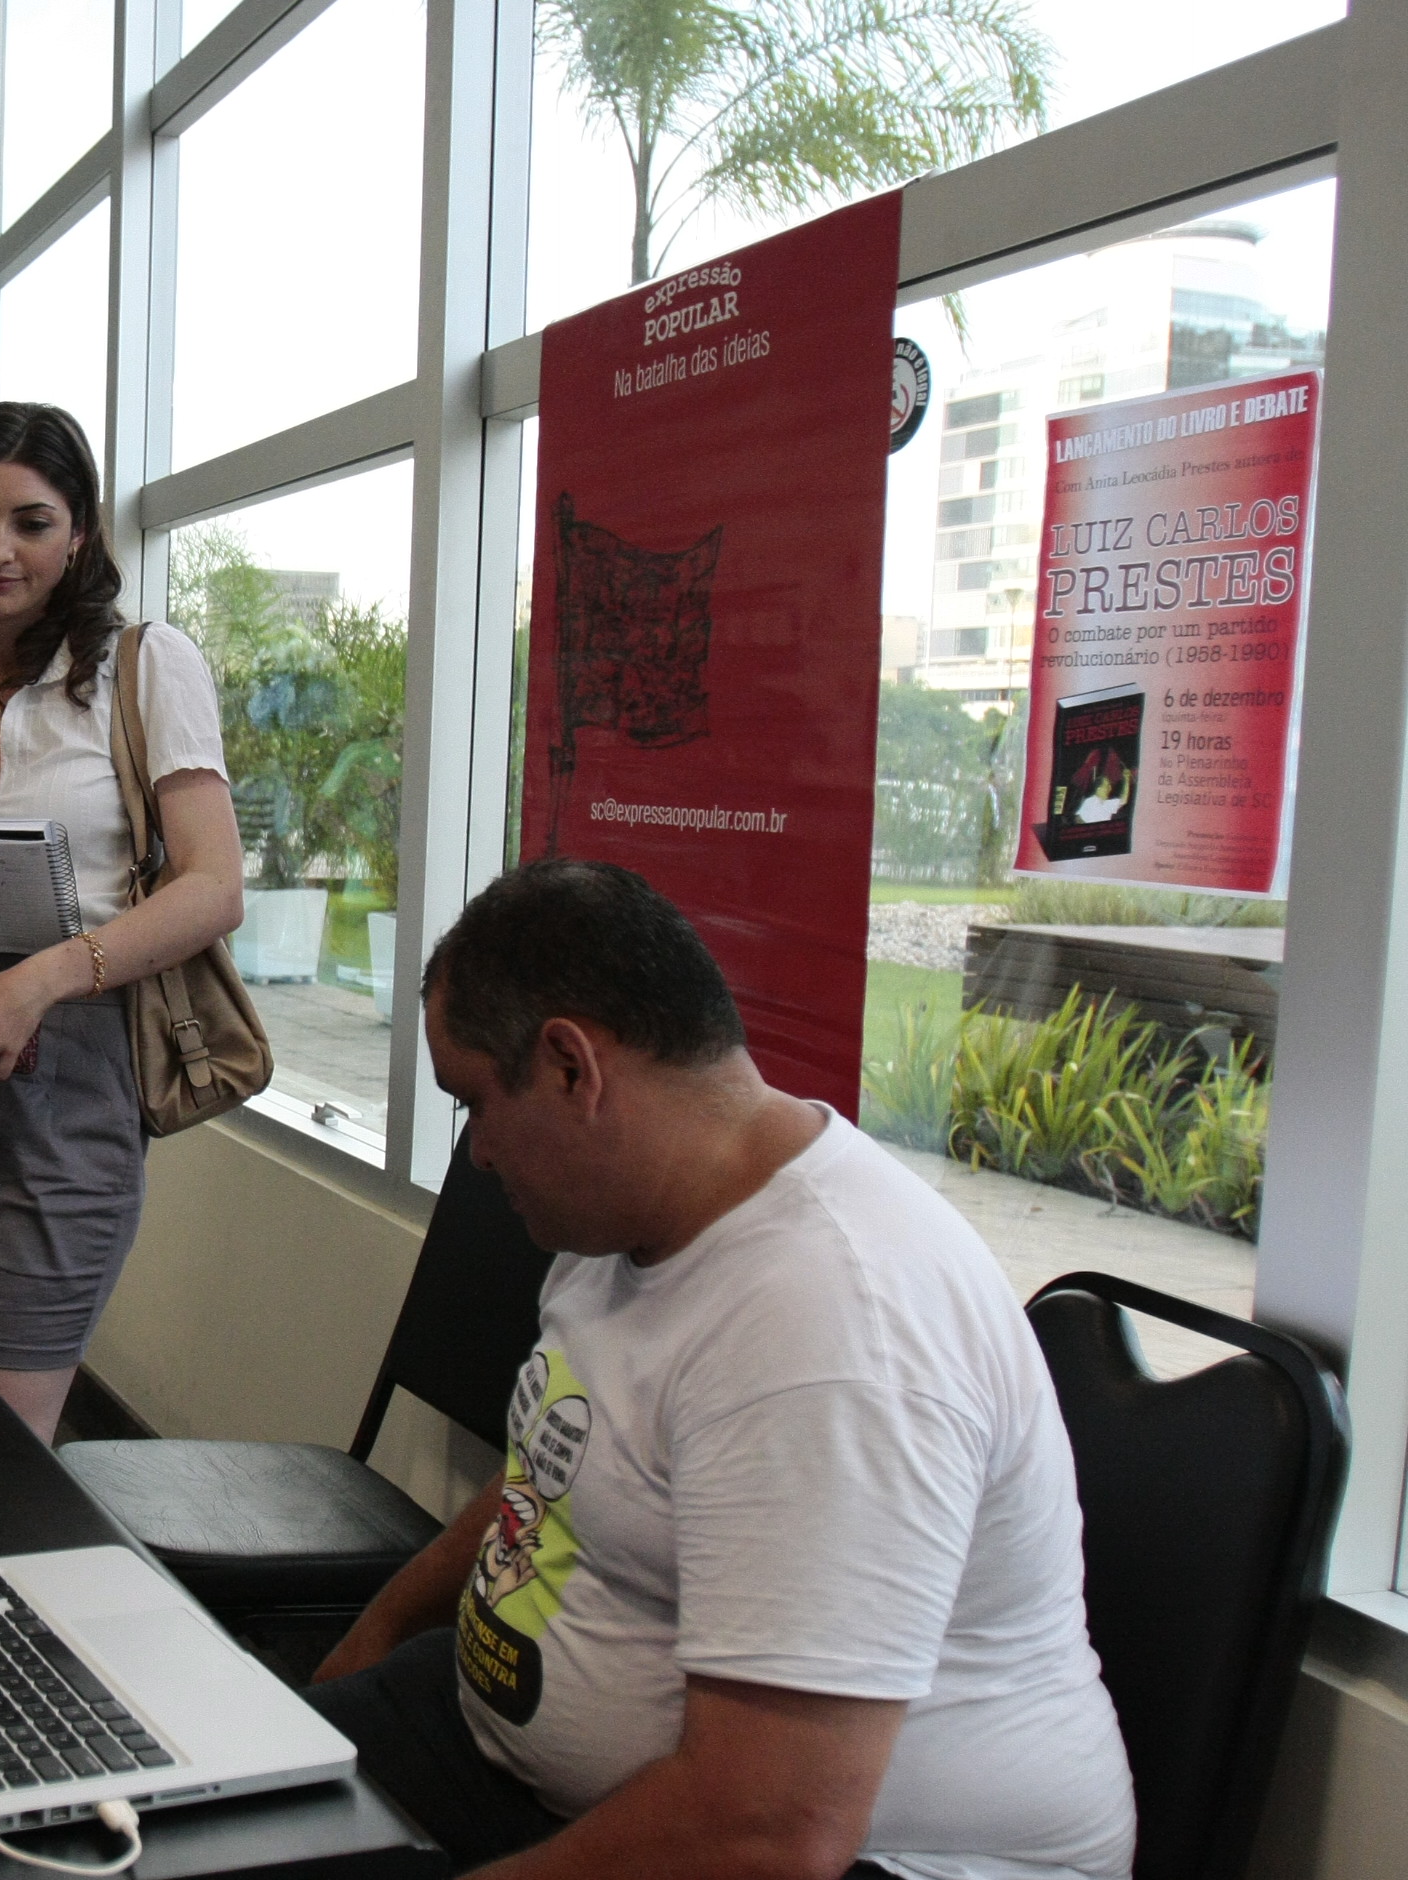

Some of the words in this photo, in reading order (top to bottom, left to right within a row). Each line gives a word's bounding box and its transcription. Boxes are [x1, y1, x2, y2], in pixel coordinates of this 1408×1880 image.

[643, 261, 742, 314] expressão
[643, 290, 740, 346] POPULAR
[614, 369, 632, 398] Na
[635, 354, 686, 392] batalha
[691, 345, 718, 376] das
[723, 329, 771, 366] ideias
[896, 342, 918, 361] não
[915, 367, 929, 406] legal
[1055, 420, 1152, 463] LANÇAMENTO
[1157, 417, 1177, 443] DO
[1180, 403, 1226, 438] LIVRO
[1230, 400, 1241, 427] E
[1244, 385, 1309, 424] DEBATE
[1055, 479, 1082, 495] Com
[1085, 475, 1119, 491] Anita
[1122, 465, 1177, 487] Leocádia
[1181, 459, 1231, 478] Prestes
[1048, 516, 1134, 559] LUIZ
[1145, 495, 1299, 548] CARLOS
[1043, 546, 1296, 618] PRESTES
[1048, 627, 1060, 644] O
[1064, 625, 1132, 644] combate
[1136, 624, 1167, 643] por
[1172, 623, 1201, 638] um
[1207, 615, 1278, 640] partido
[1040, 647, 1160, 669] revolucionário
[1163, 689, 1175, 708] 6
[1179, 688, 1198, 708] de
[1202, 687, 1284, 708] dezembro
[1160, 730, 1182, 751] 19
[1186, 731, 1233, 752] horas
[1157, 771, 1174, 787] da
[590, 797, 788, 834] sc@expressaopopular.com.br
[1157, 792, 1227, 809] Legislativa
[472, 1641, 518, 1692] CONTRA
[498, 1640, 520, 1667] EM
